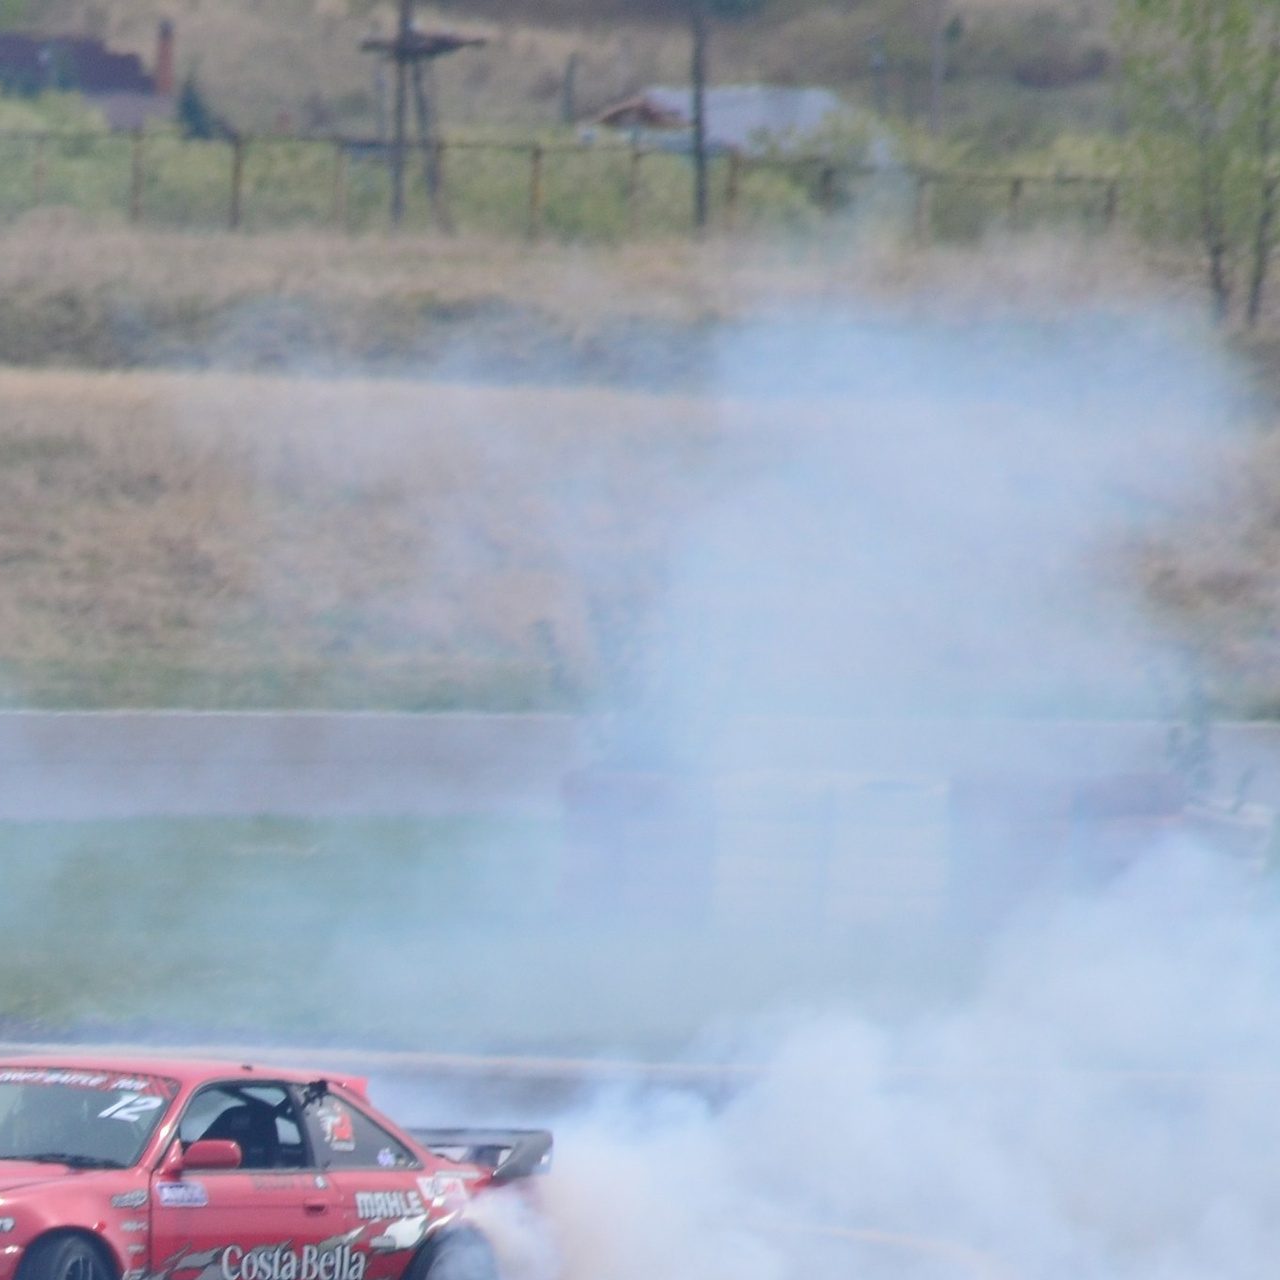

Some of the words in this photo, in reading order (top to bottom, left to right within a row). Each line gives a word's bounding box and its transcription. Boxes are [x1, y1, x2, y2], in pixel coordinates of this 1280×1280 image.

[97, 1092, 164, 1122] 12
[355, 1190, 425, 1219] MAHLE
[300, 1244, 366, 1280] Bella
